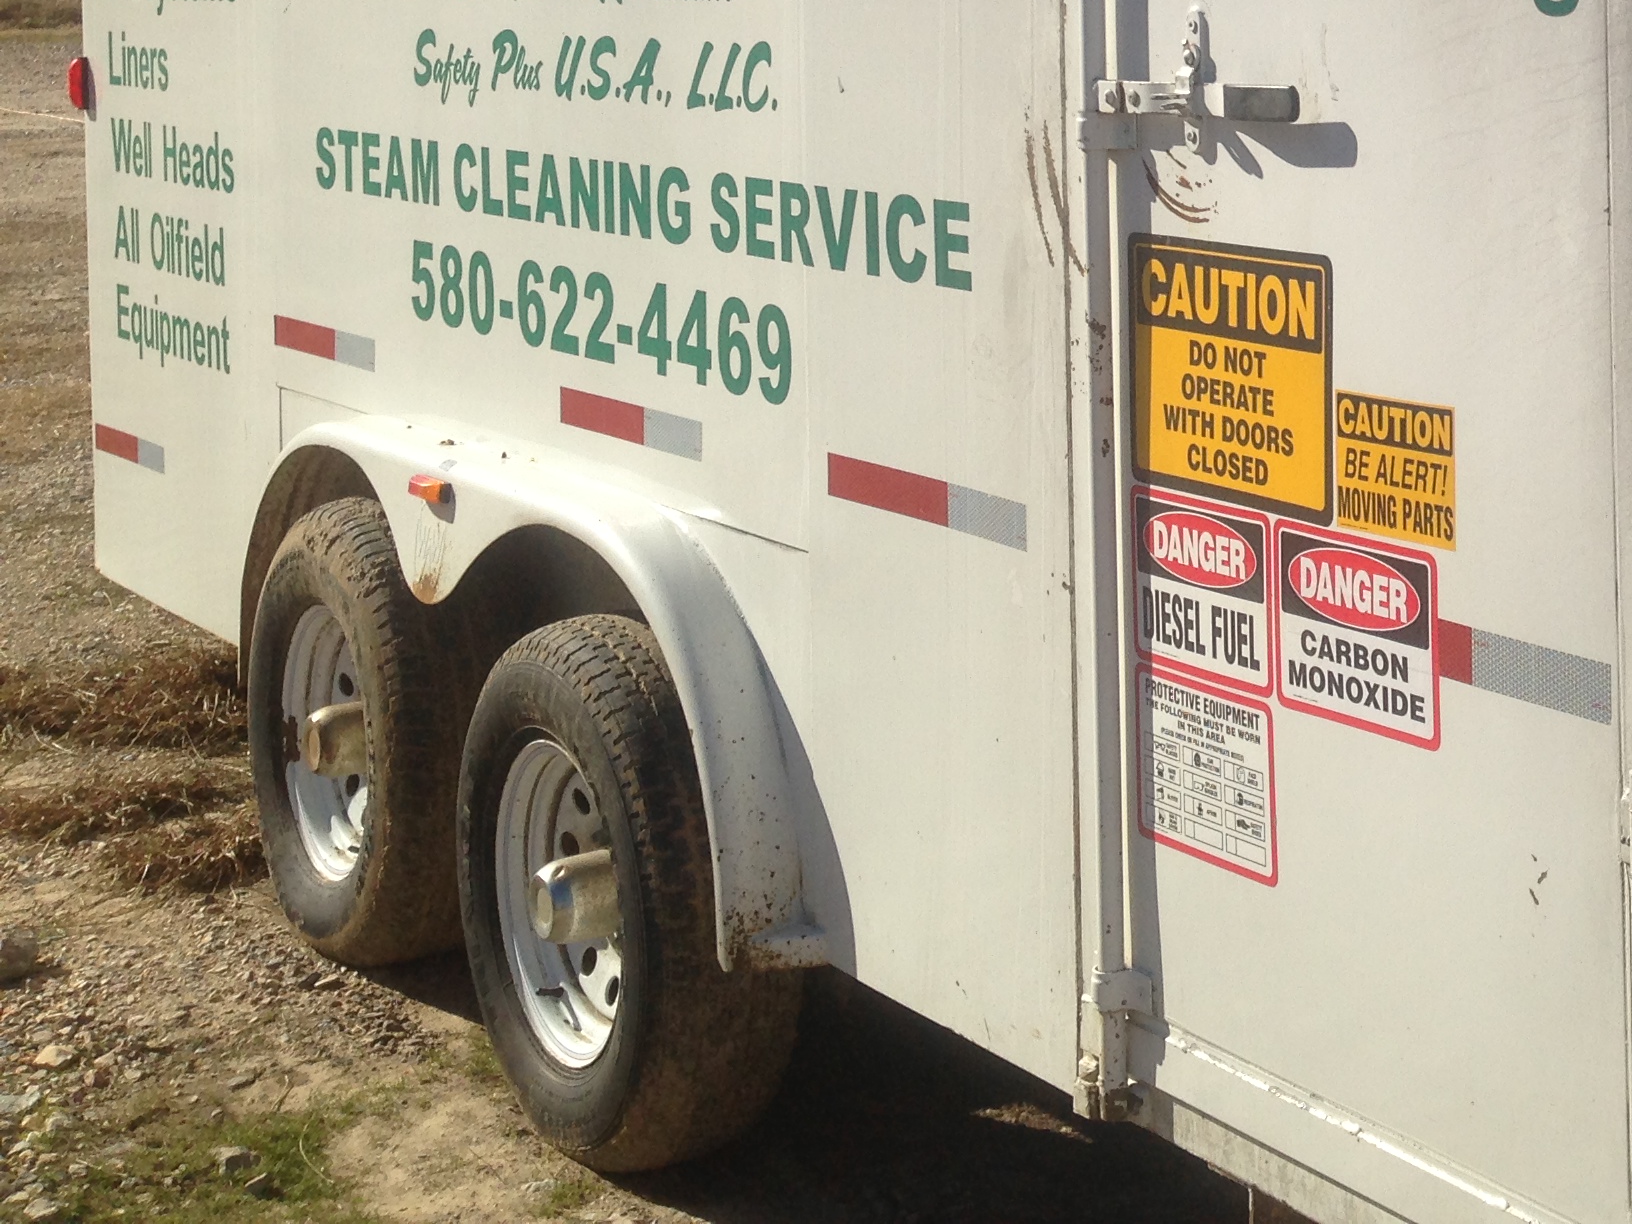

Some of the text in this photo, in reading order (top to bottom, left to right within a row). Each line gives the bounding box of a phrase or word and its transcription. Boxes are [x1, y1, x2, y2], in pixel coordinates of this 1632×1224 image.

[108, 31, 169, 91] Liners
[413, 28, 481, 107] Safety
[491, 29, 542, 93] Plus
[686, 40, 778, 113] L.L.C.
[111, 117, 235, 195] Well Heads
[316, 127, 972, 292] STEAM CLEANING SERVICE
[114, 205, 226, 288] All Oilfield
[116, 284, 231, 375] Equipment
[410, 240, 792, 406] 580-622-4469
[1142, 259, 1315, 340] CAUTION
[1189, 339, 1267, 379] DO NOT
[1181, 372, 1275, 417] OPERATE
[1338, 398, 1450, 451] CAUTION
[1163, 404, 1294, 457] WITH DOORS
[1187, 443, 1269, 486] CLOSED
[1344, 448, 1448, 496] BE ALERT!
[1338, 486, 1454, 542] MOVING PARTS
[1153, 519, 1246, 580] DANGER
[1300, 556, 1408, 624] DANGER
[1142, 585, 1260, 672] DIESEL FUEL
[1300, 629, 1409, 684] CARBON
[1145, 677, 1260, 731] PROTECTIVE EQUIPMENT
[1145, 698, 1261, 745] THE FOLLOWING MUST BE WORN
[1288, 659, 1426, 724] MONOXIDE
[1177, 720, 1186, 730] IN
[1187, 723, 1204, 737] THIS
[1206, 731, 1226, 745] AREA
